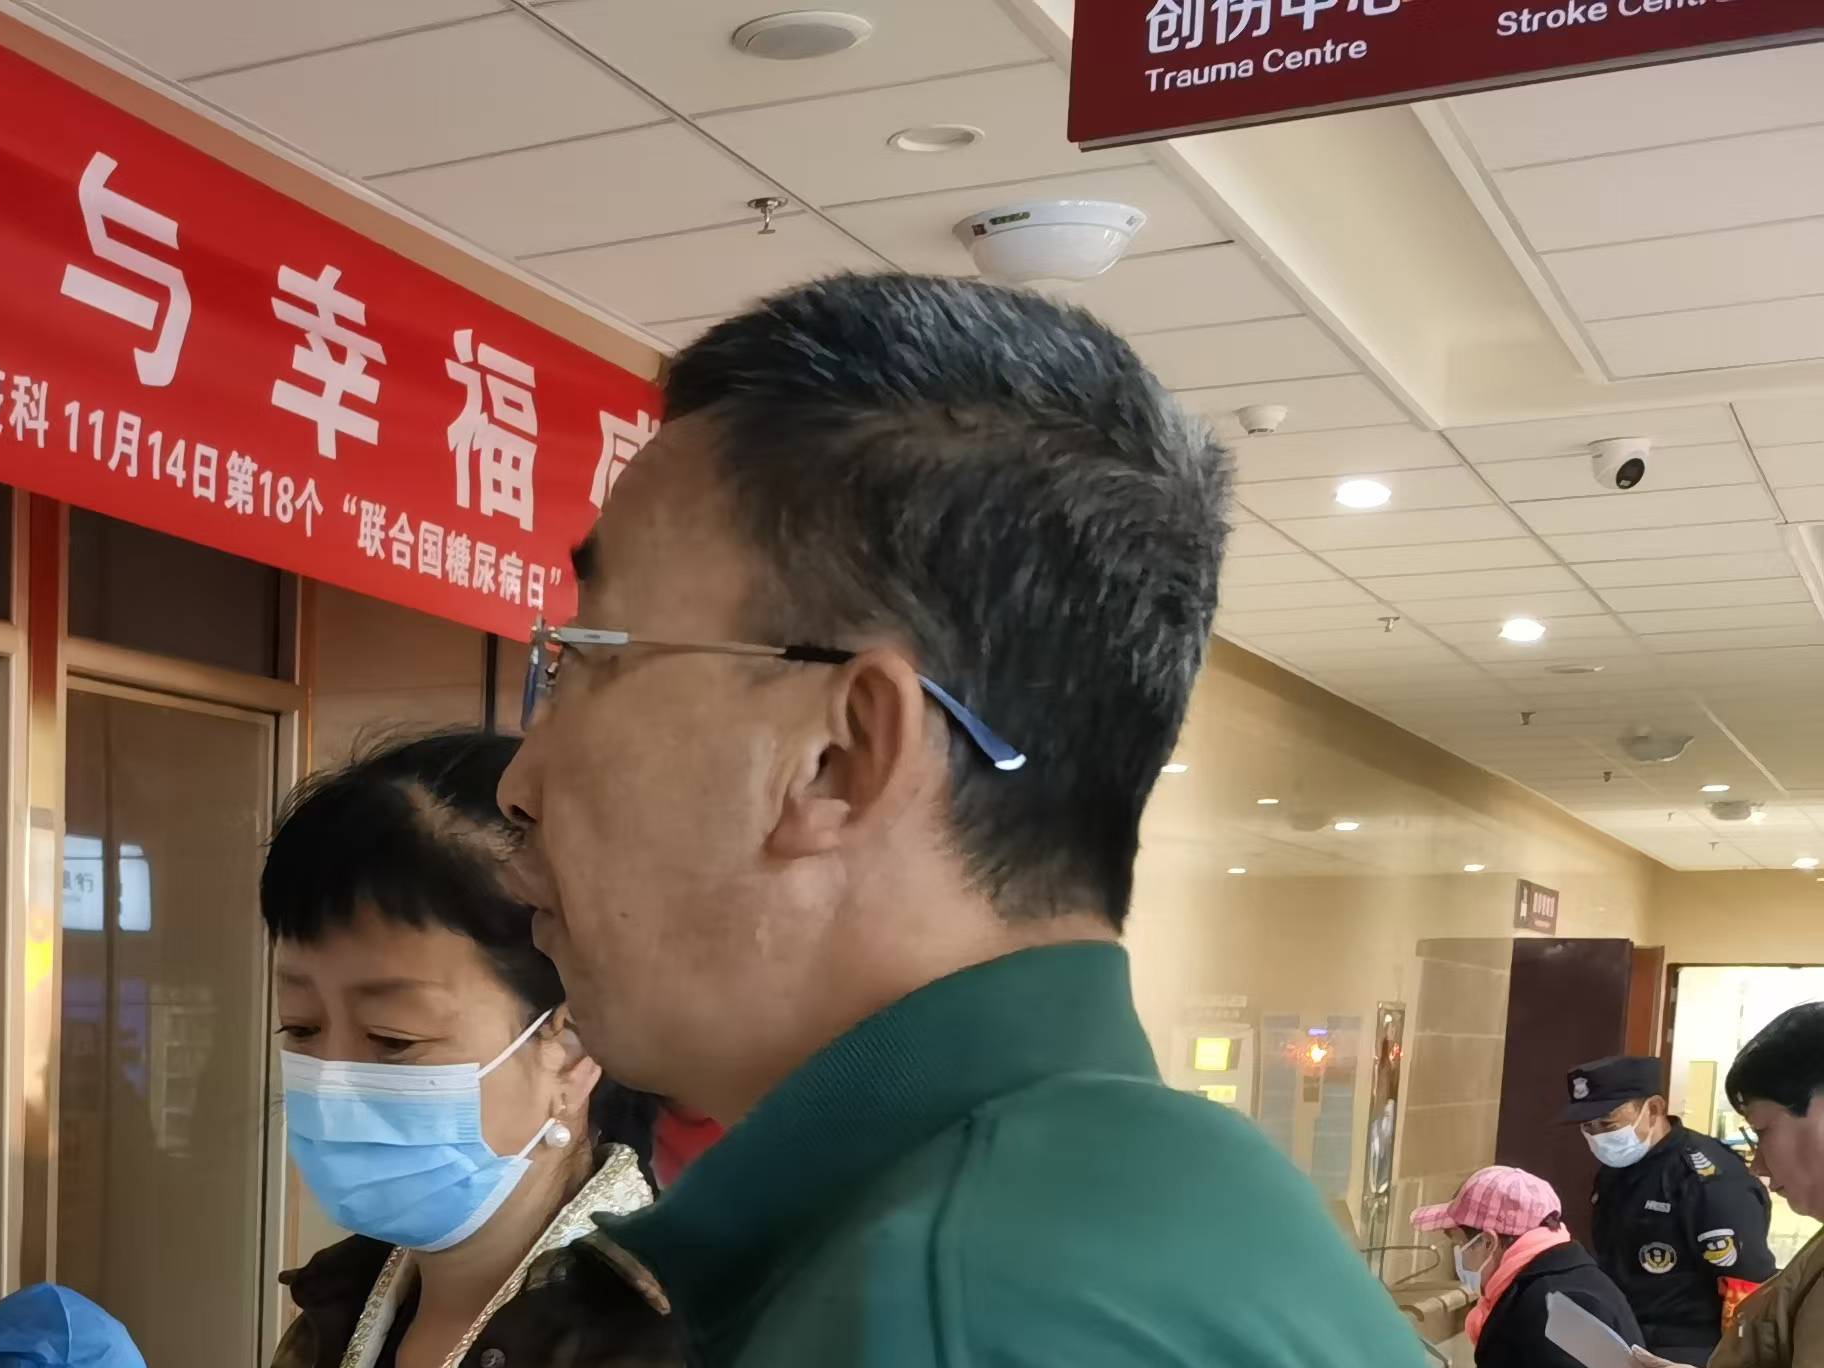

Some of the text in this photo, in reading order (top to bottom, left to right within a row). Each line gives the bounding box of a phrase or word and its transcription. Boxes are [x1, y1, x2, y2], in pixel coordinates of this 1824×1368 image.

[1145, 0, 1401, 53] 创伤中
[1497, 0, 1608, 36] Stroke
[1145, 39, 1368, 92] Trauma Centre
[64, 400, 324, 538] 11月14日第18个
